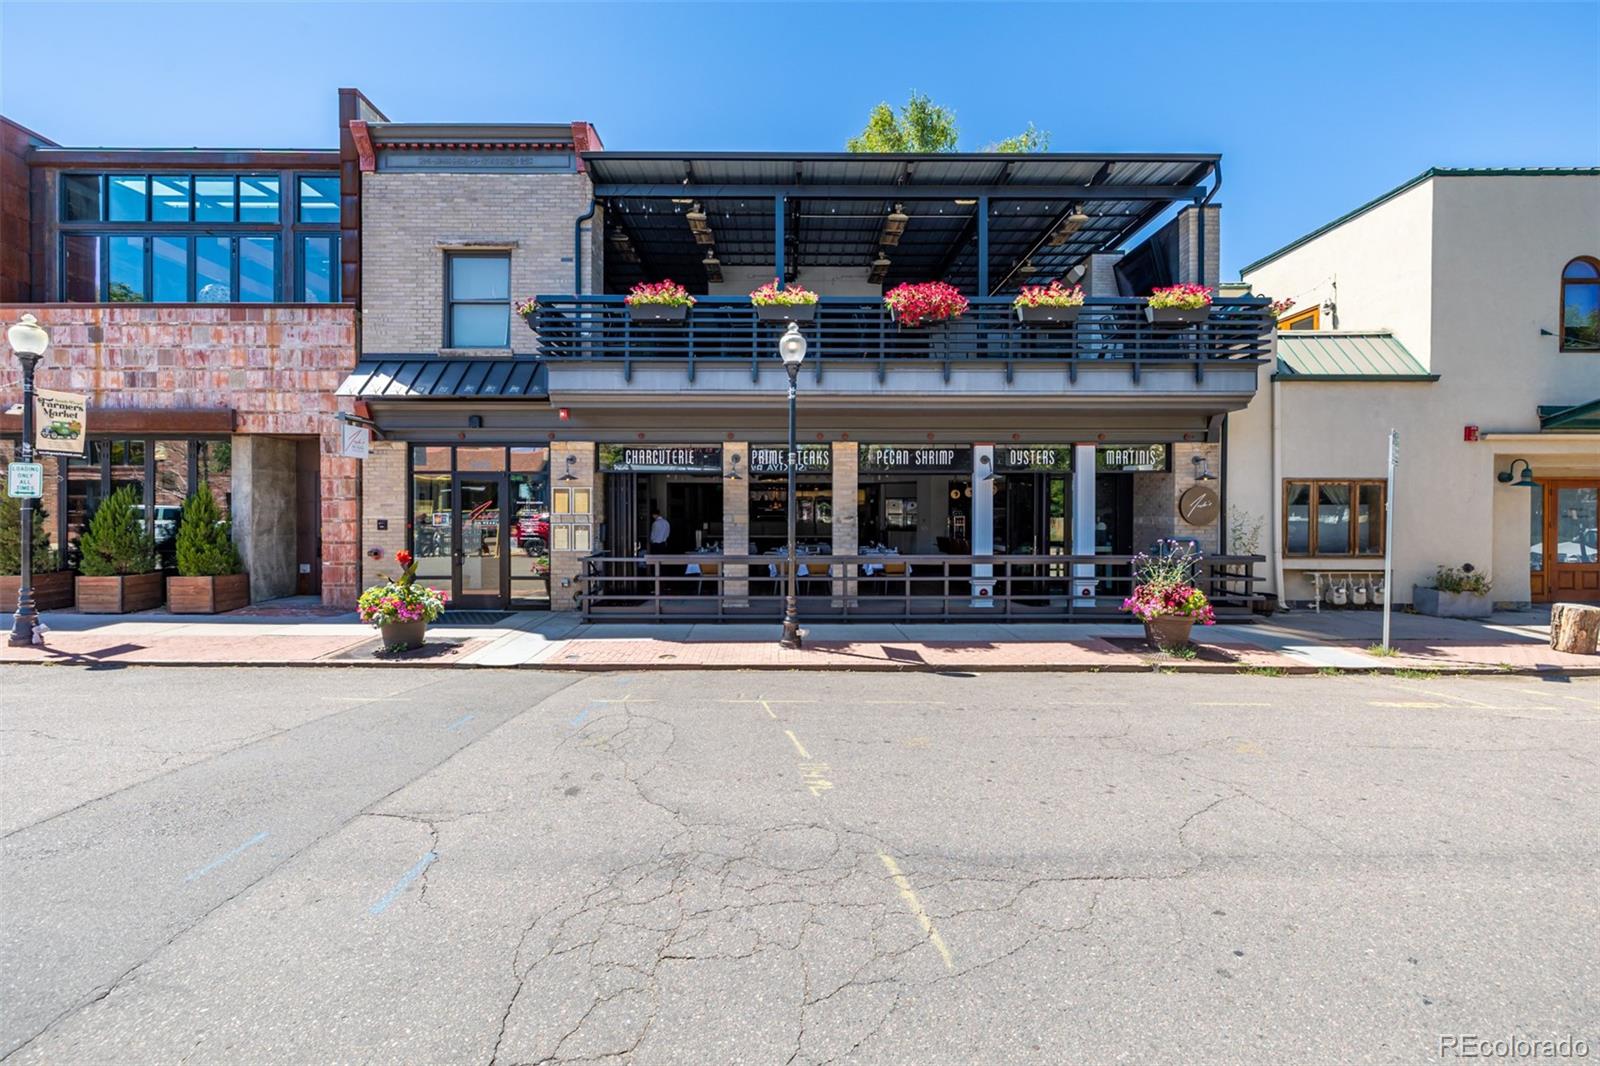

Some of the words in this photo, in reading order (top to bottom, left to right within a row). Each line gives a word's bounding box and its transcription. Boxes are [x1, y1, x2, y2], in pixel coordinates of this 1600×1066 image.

[37, 398, 84, 411] Farmers
[43, 408, 78, 418] Market
[626, 449, 695, 465] CHARCUTERIE
[751, 449, 784, 465] PRIME
[790, 450, 829, 465] TEAKS
[876, 449, 909, 465] PECAN
[915, 449, 954, 465] SHRIMP
[1010, 449, 1055, 465] OYSTERS
[1106, 449, 1156, 465] MARTINIS
